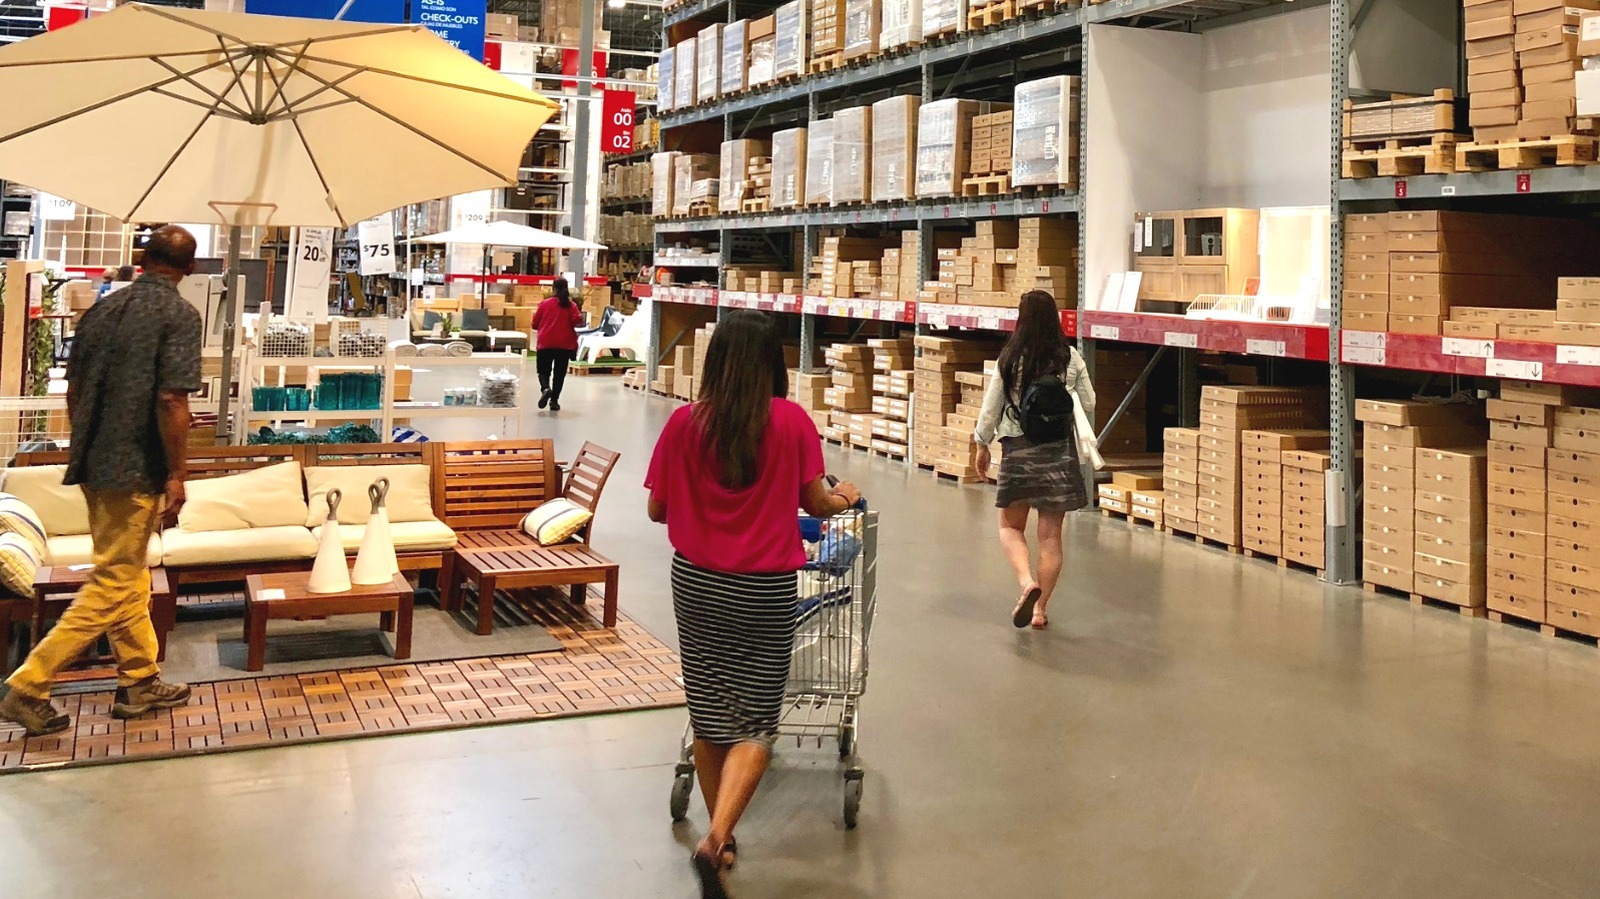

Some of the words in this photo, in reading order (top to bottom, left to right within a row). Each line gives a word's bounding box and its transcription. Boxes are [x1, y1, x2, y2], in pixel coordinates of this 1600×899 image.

[420, 12, 479, 25] CHECK-OUTS
[613, 112, 632, 126] 00
[613, 135, 630, 148] 02
[303, 245, 319, 261] 20
[363, 243, 390, 258] $75
